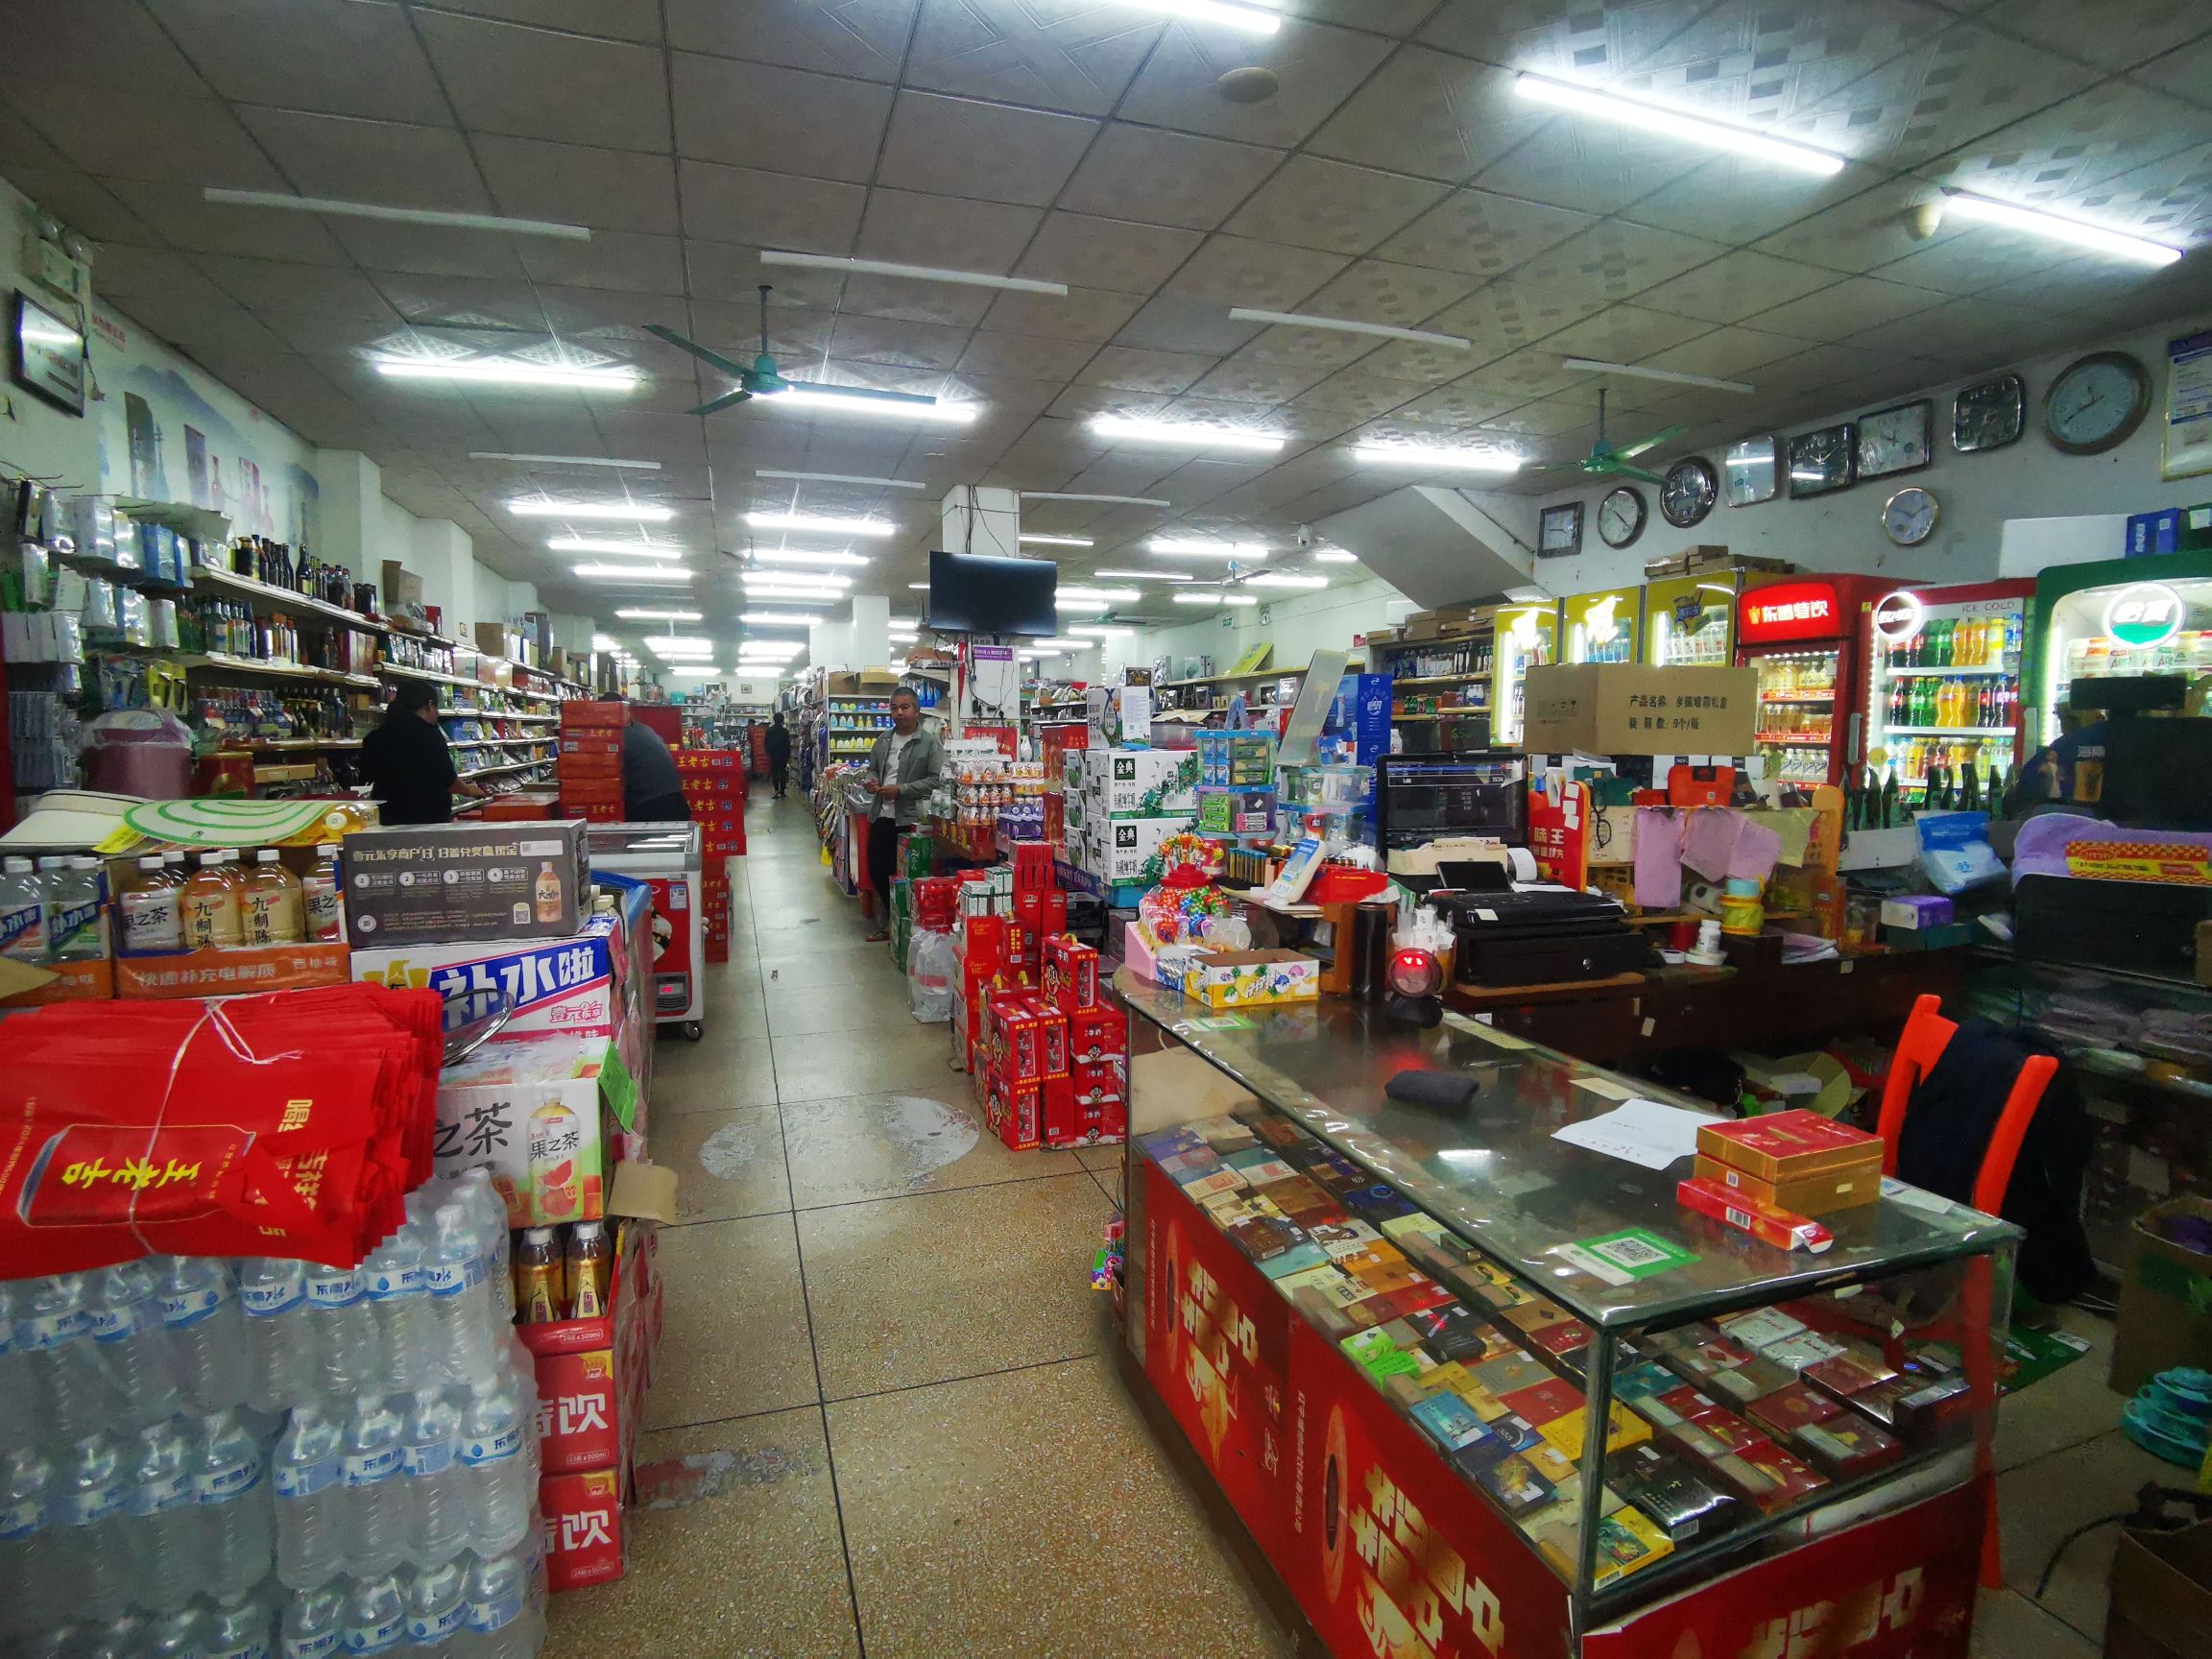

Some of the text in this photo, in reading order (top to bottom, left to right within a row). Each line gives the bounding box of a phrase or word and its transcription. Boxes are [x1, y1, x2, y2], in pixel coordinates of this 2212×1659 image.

[1763, 600, 1829, 622] 东鹏特饮
[1962, 601, 2015, 613] ICE COLD
[677, 756, 709, 768] 王老吉
[1116, 760, 1133, 775] 金典
[681, 779, 711, 791] 王老吉
[1118, 828, 1135, 842] 金典
[439, 946, 595, 1029] 补水啦
[530, 1131, 579, 1162] 果之茶
[61, 1156, 201, 1191] 王老吉
